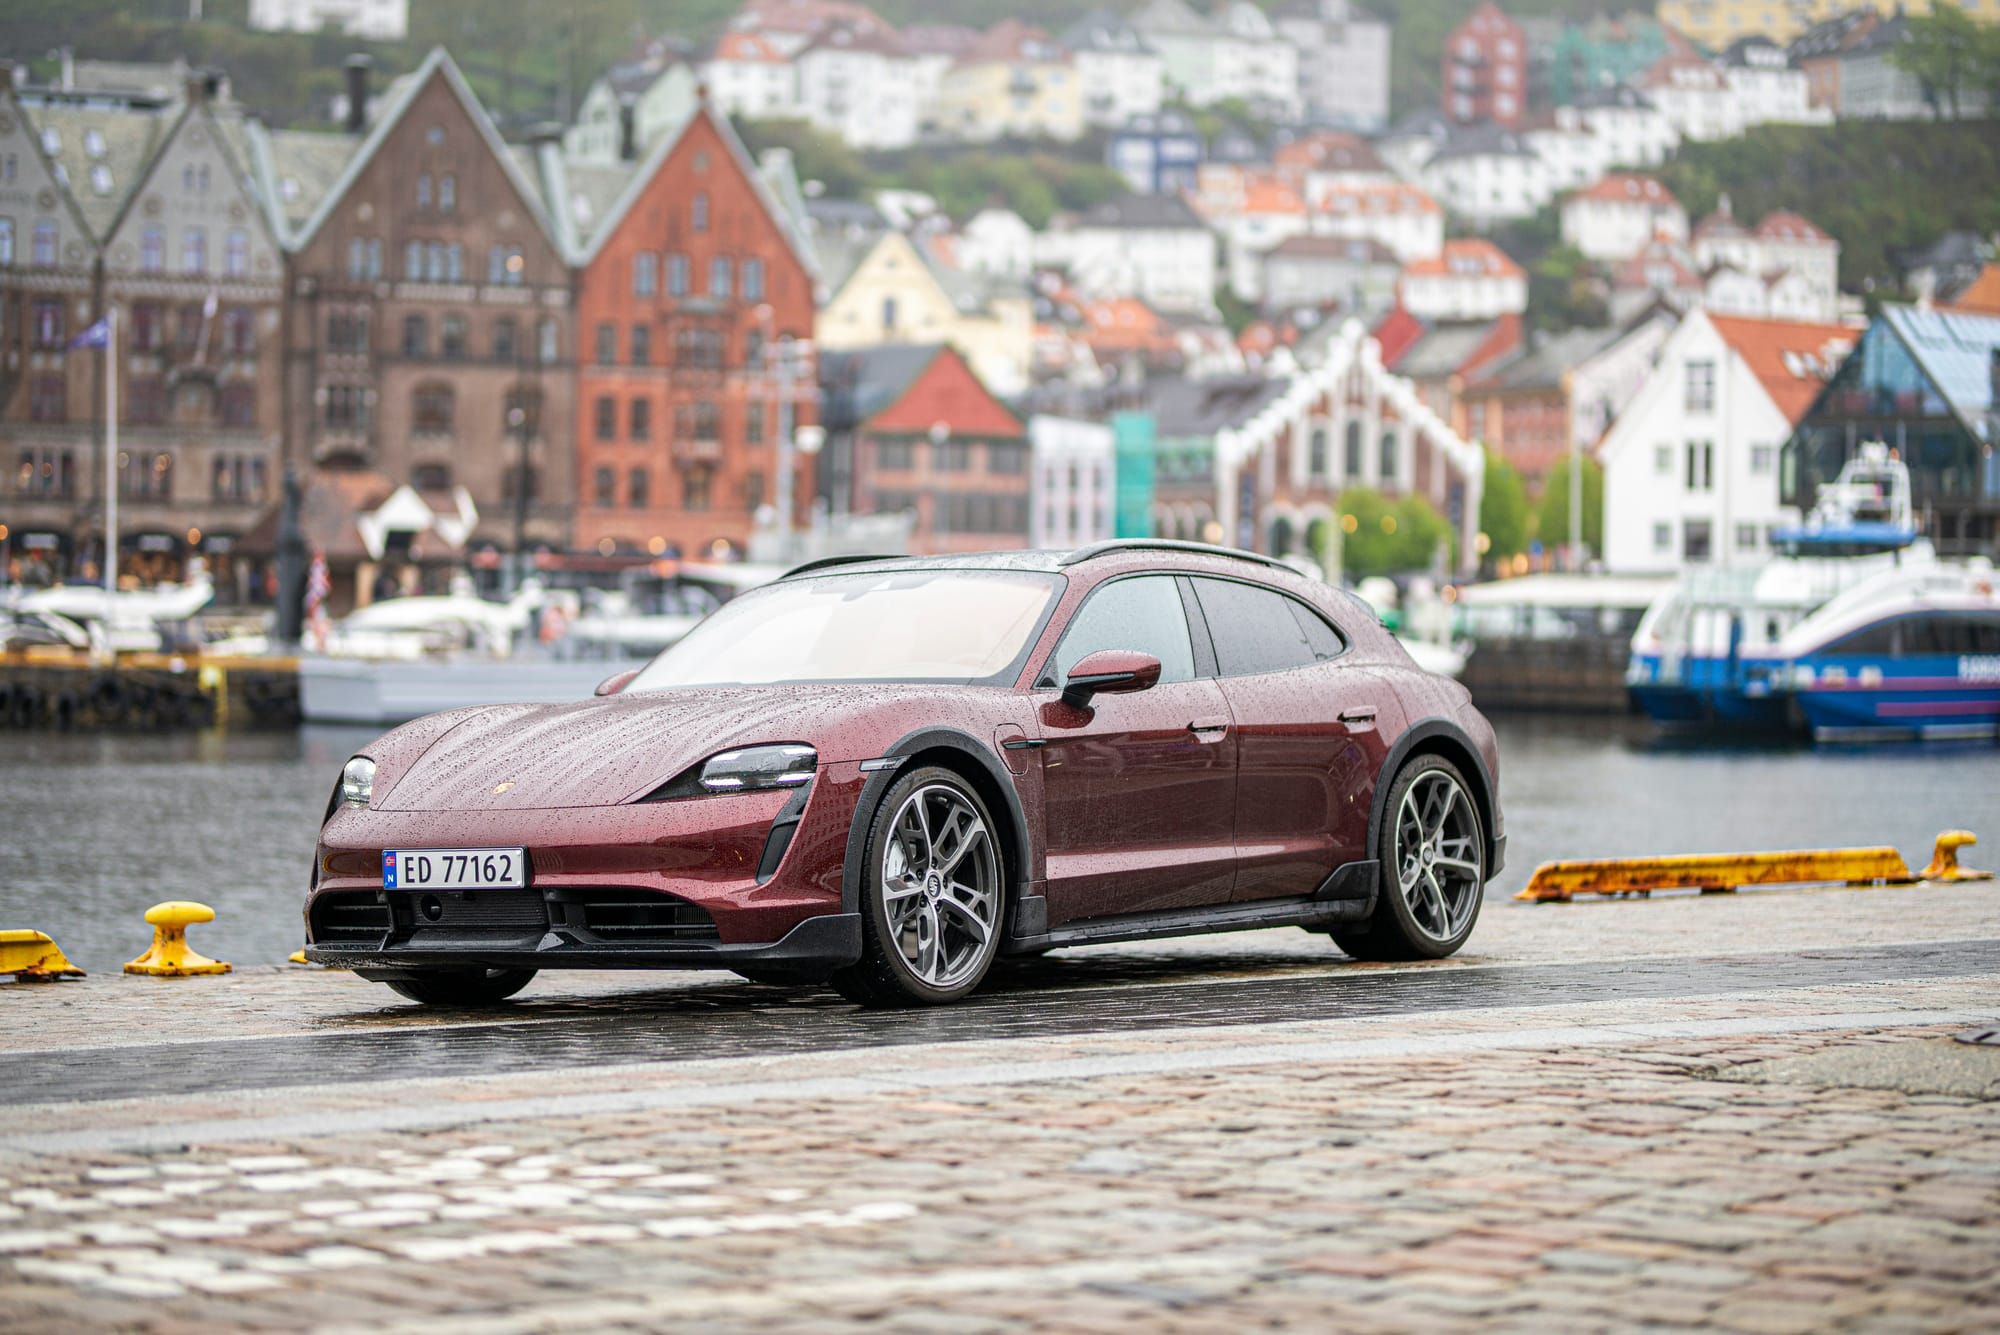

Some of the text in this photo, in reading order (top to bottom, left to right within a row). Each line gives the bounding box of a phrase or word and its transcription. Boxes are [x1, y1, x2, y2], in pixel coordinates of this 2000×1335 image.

[405, 855, 513, 883] ED 77162
[387, 874, 394, 883] N
